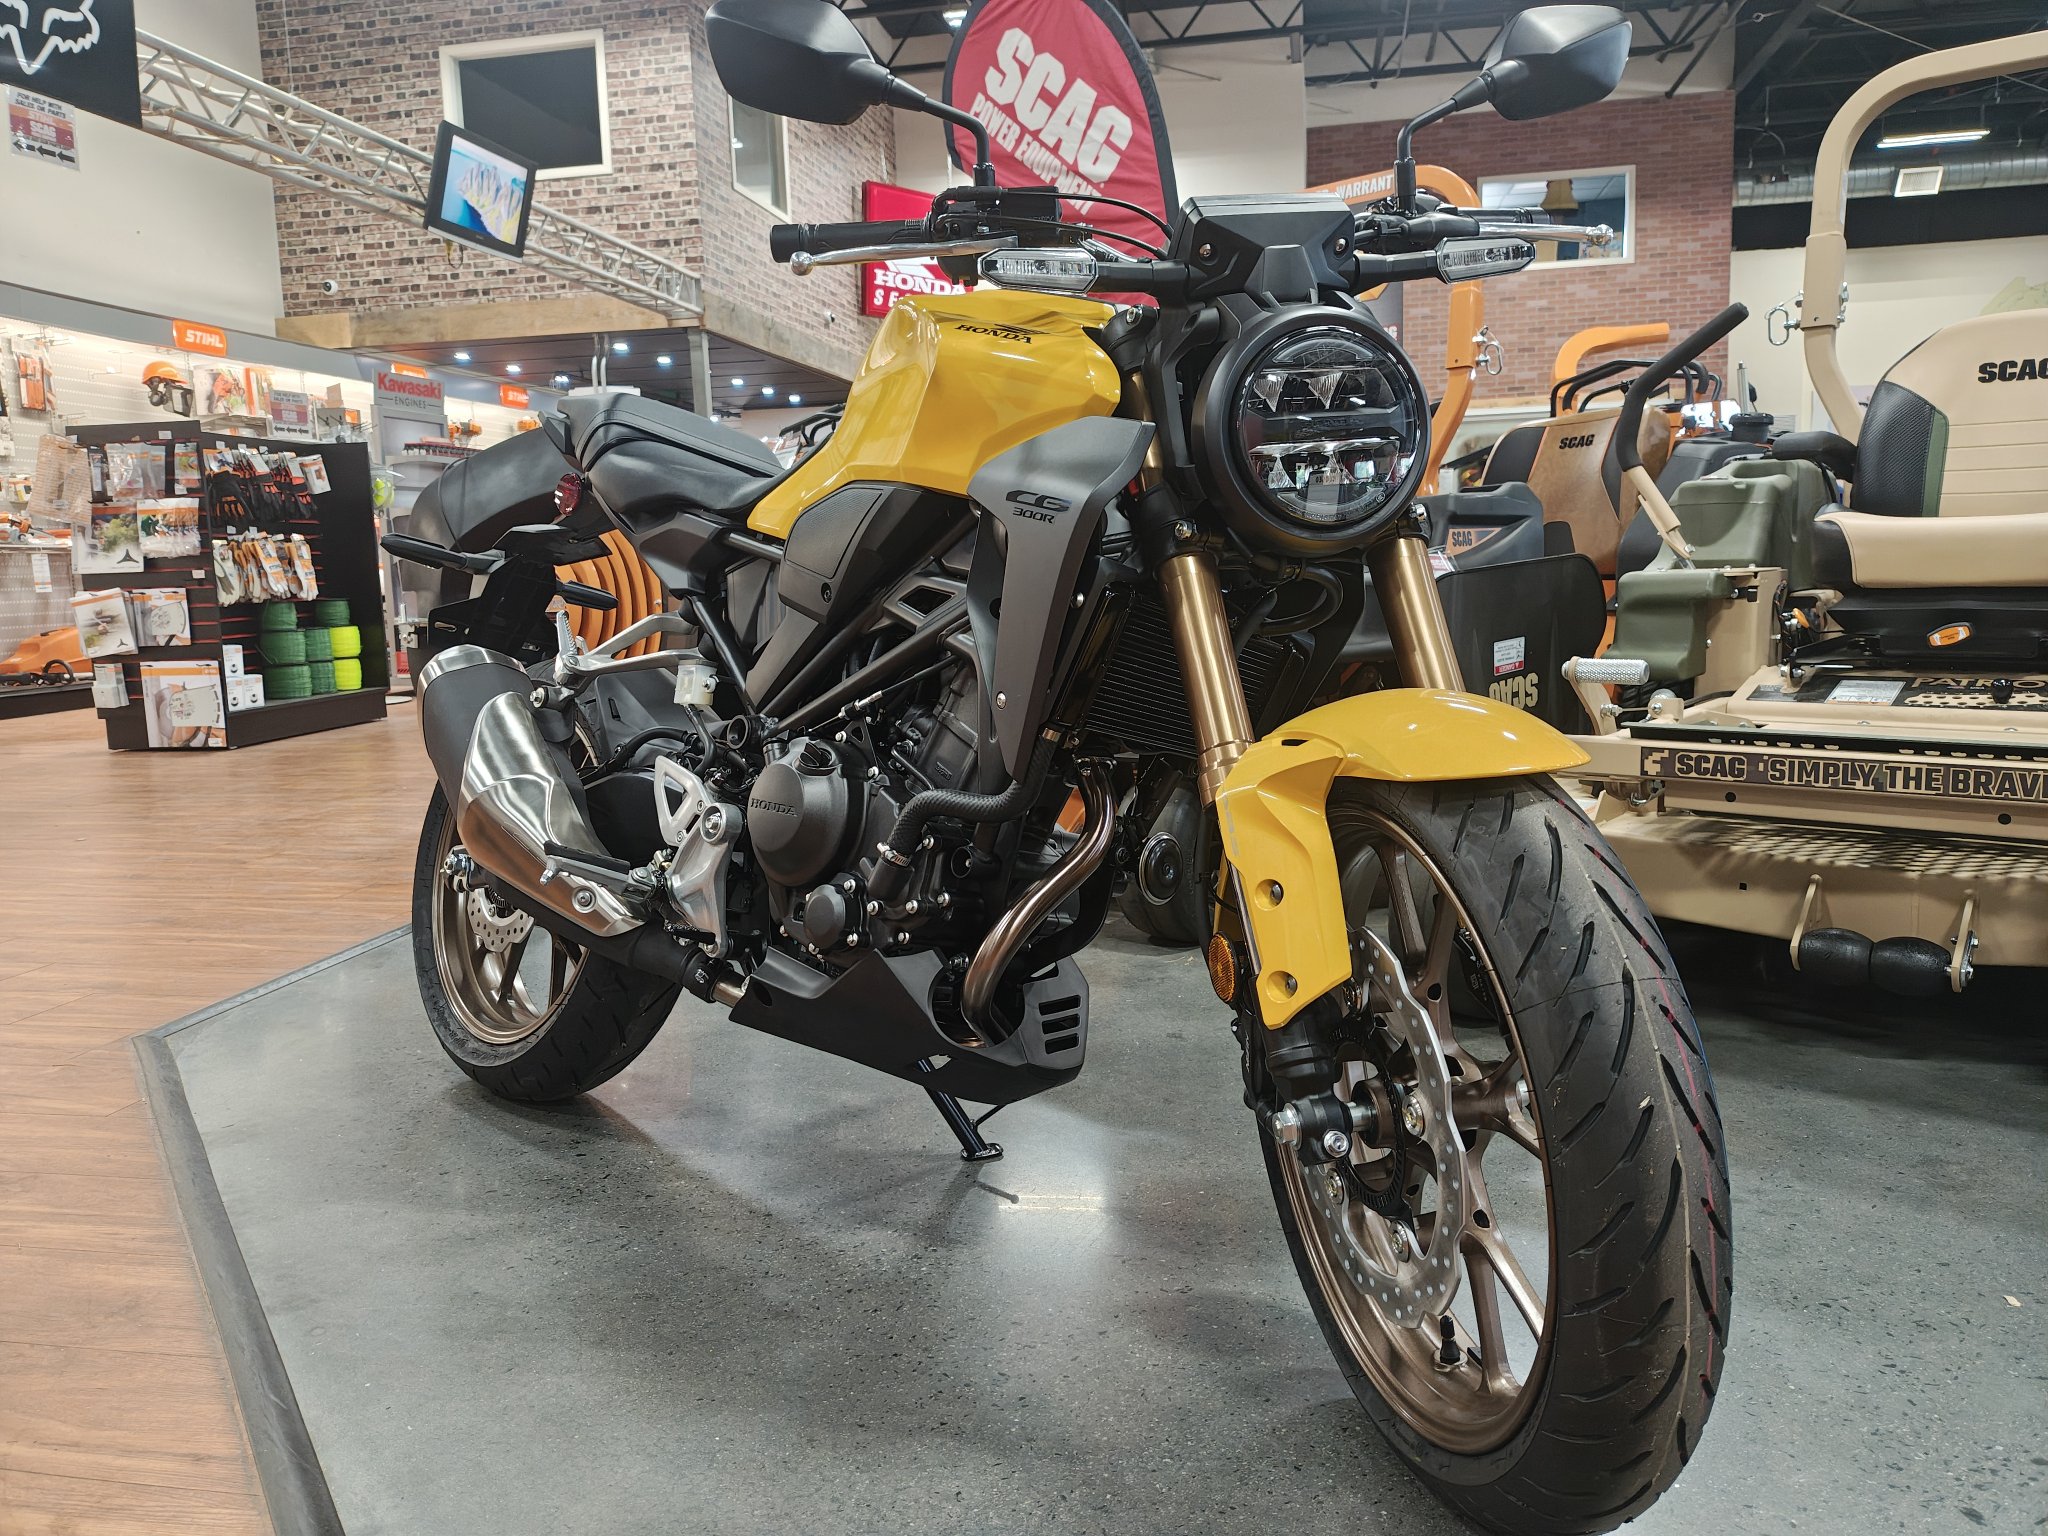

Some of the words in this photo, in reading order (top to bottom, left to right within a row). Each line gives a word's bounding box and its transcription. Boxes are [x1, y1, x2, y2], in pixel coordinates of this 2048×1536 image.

[985, 27, 1133, 184] SCAG
[969, 91, 1021, 153] POWER
[1014, 132, 1102, 216] EQUIPMENT
[874, 268, 966, 296] HONDA
[185, 329, 224, 348] STIHL
[955, 324, 1032, 344] HONDA
[378, 372, 442, 399] Kawasaki
[394, 397, 427, 409] ENGINES
[1559, 434, 1595, 449] SCAG
[1012, 507, 1055, 524] 300R
[1451, 530, 1473, 547] SCAG
[1675, 752, 1747, 781] SCAG
[1883, 763, 1944, 795] THE
[750, 798, 797, 817] HONDA
